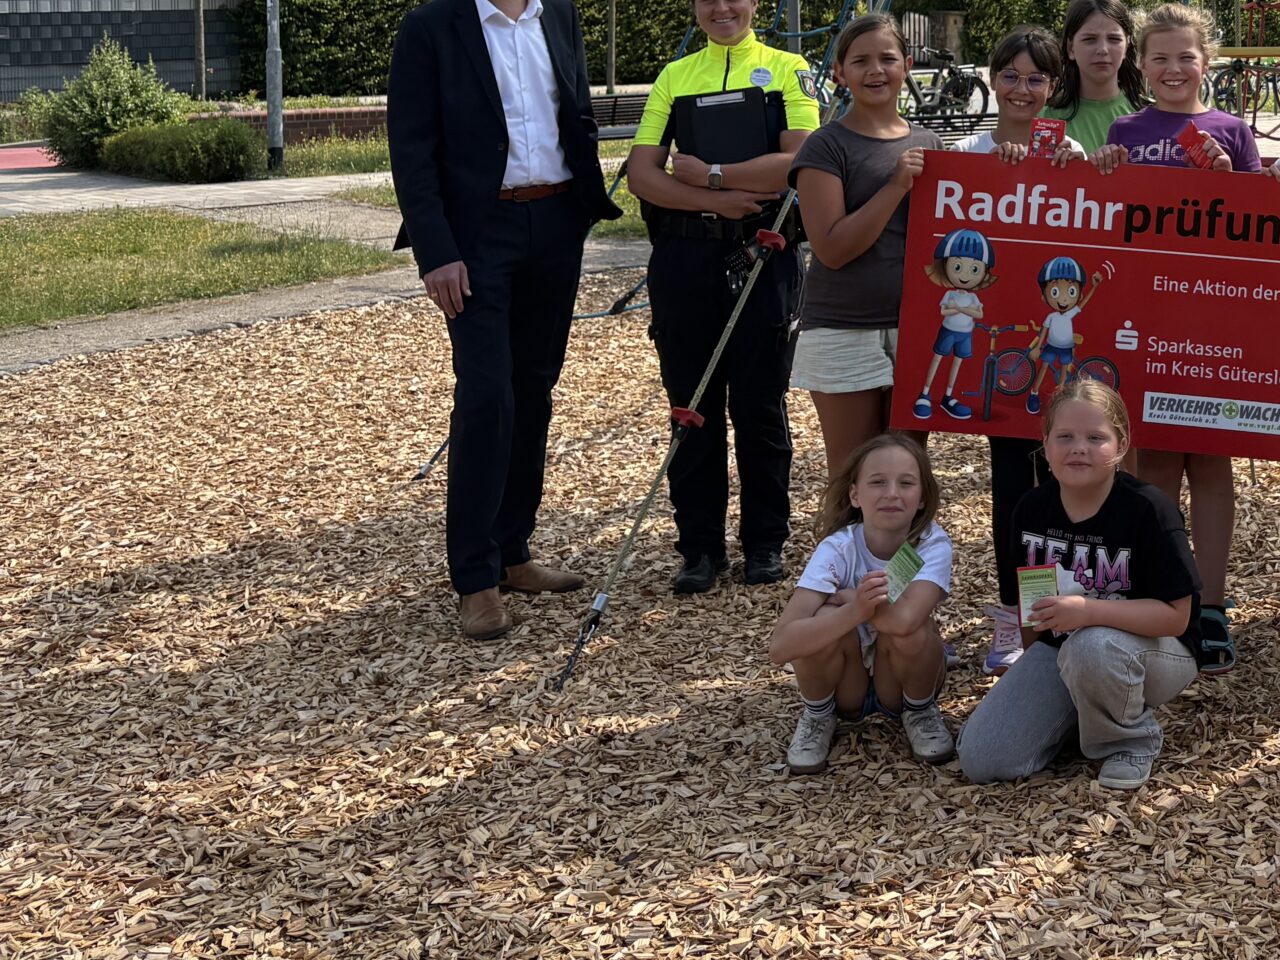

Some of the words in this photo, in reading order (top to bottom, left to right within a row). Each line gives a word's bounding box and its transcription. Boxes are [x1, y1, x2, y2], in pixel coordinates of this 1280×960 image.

[1153, 275, 1189, 293] Eine
[1192, 279, 1248, 298] Aktion
[1252, 284, 1280, 301] der
[1147, 336, 1243, 359] Sparkassen
[1145, 358, 1167, 374] im
[1171, 360, 1214, 379] Kreis
[1150, 396, 1223, 416] VERKEHRS
[1148, 412, 1167, 420] Kreis
[1169, 413, 1203, 423] Gütersloh
[1021, 531, 1132, 590] TEAM
